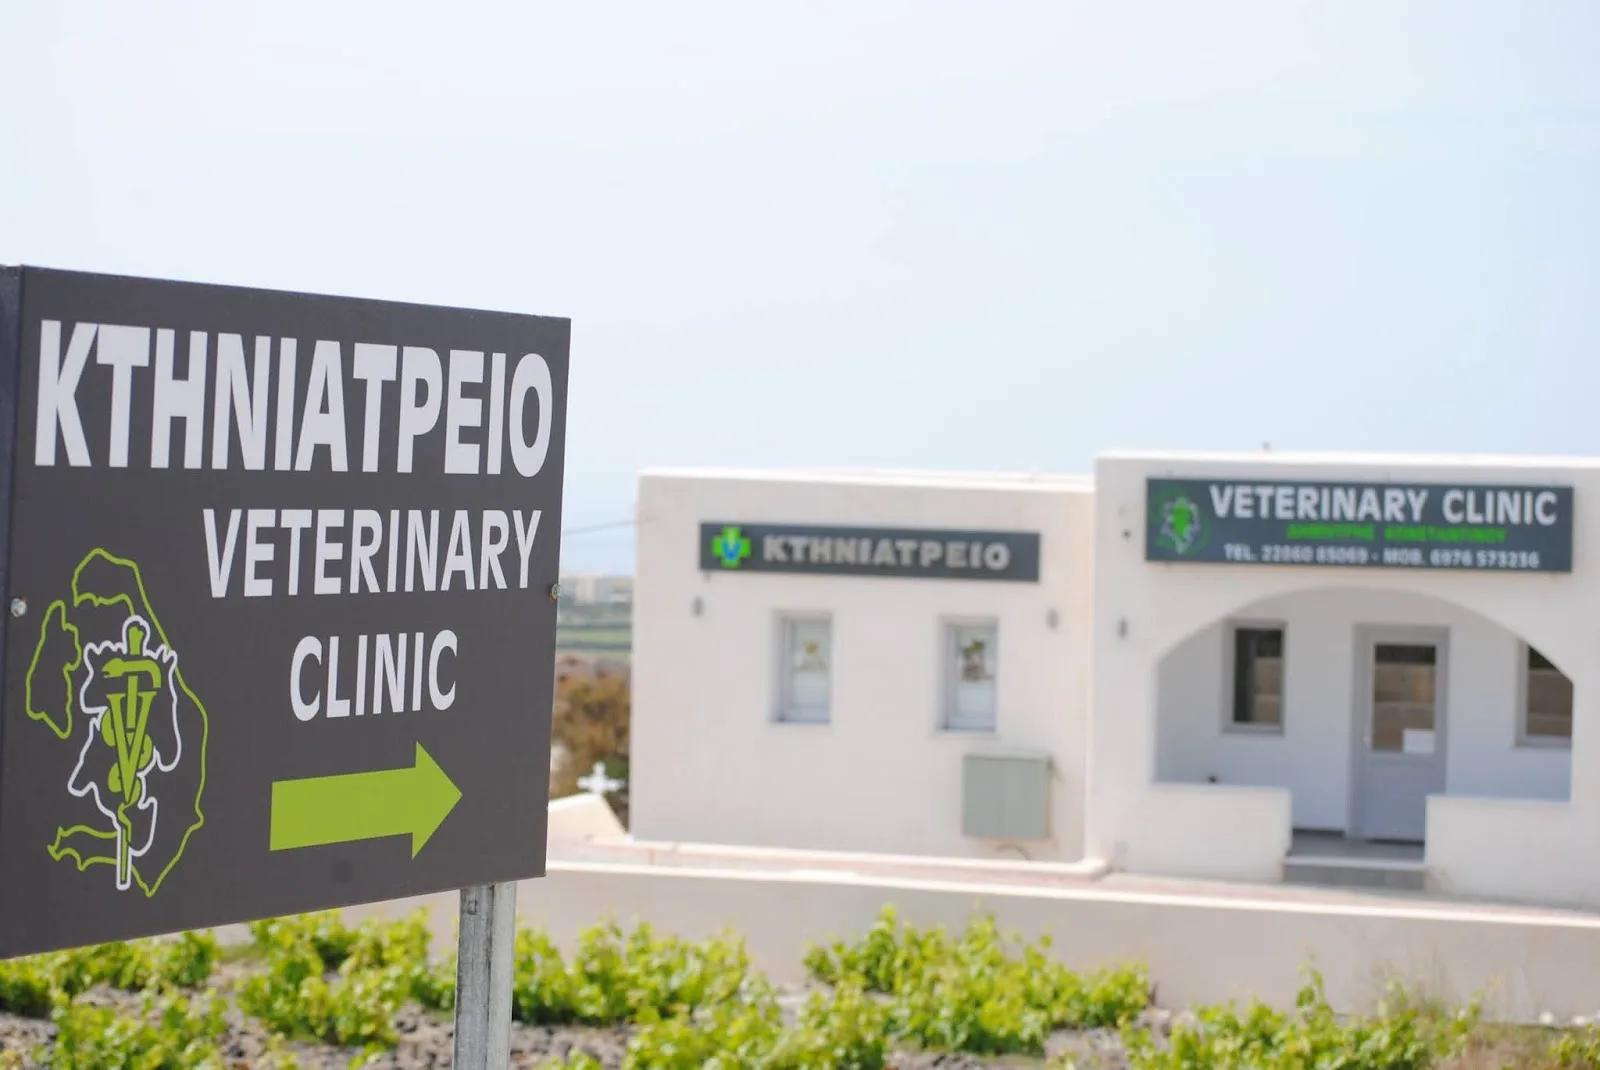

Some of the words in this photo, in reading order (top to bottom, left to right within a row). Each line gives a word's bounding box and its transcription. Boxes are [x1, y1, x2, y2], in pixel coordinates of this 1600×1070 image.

[35, 319, 553, 478] ΚΤΗΝΙΑΤΡΕΙΟ
[1209, 484, 1428, 522] VETERINARY
[1442, 489, 1558, 526] CLINIC
[202, 508, 542, 598] VETERINARY
[763, 534, 1011, 571] ΚΤΗΝΙΑΤΡΕΙΟ
[290, 629, 458, 722] CLINIC
